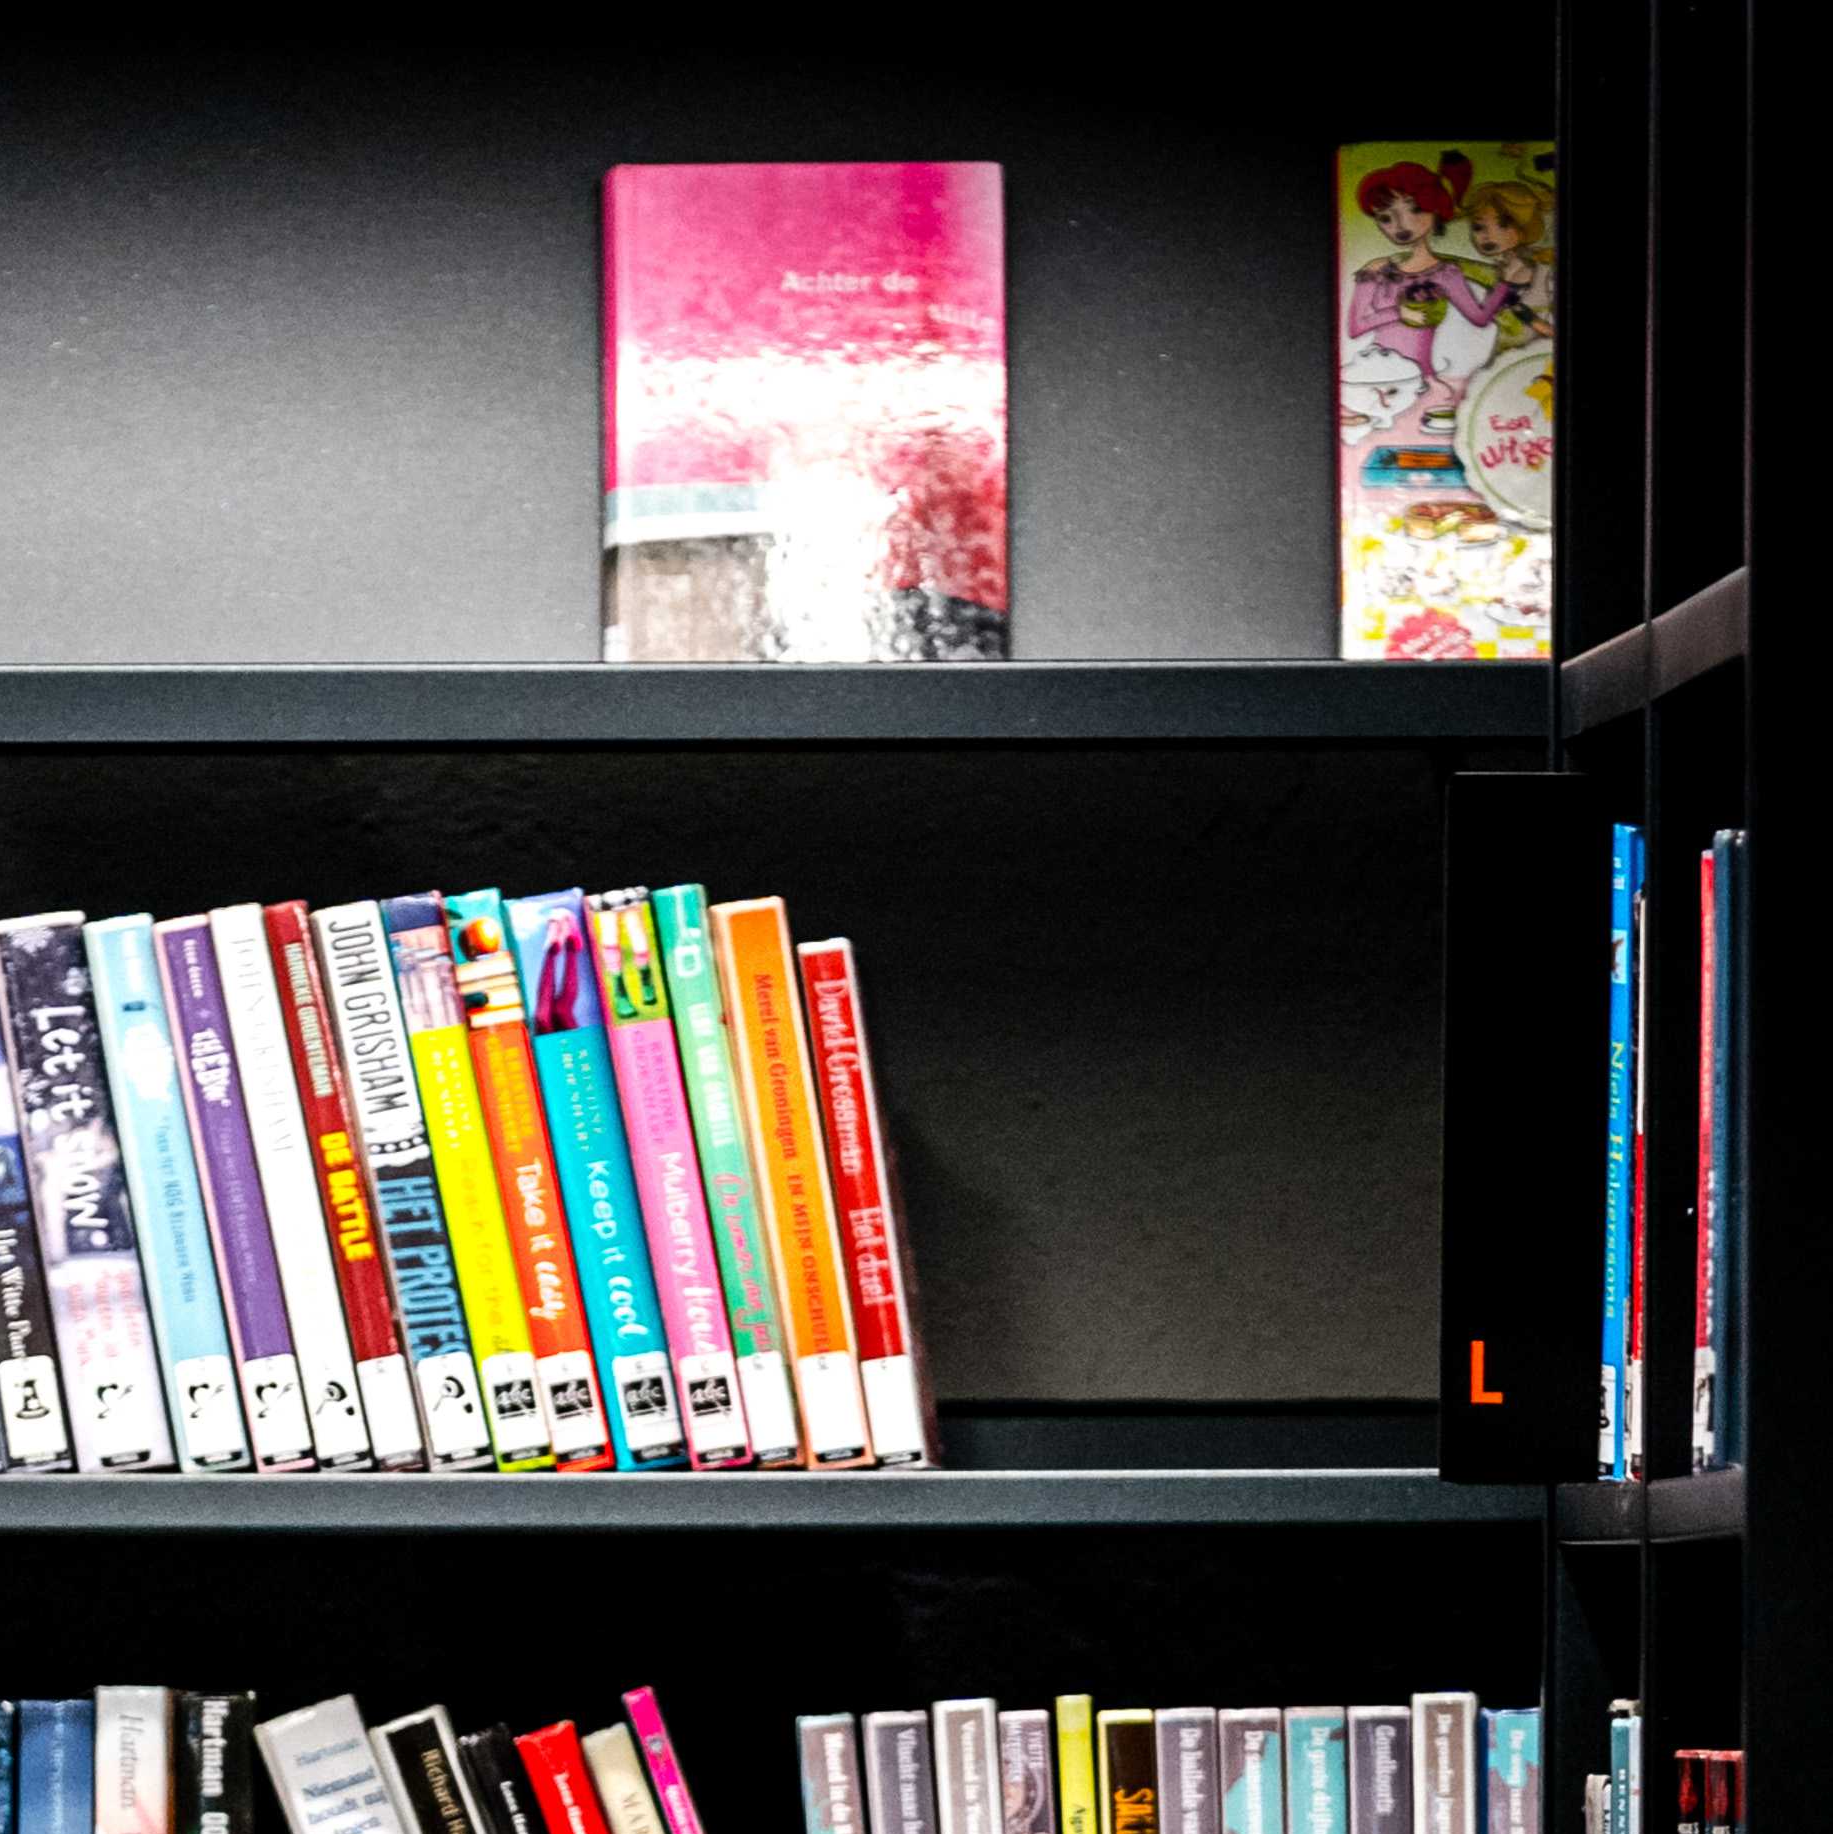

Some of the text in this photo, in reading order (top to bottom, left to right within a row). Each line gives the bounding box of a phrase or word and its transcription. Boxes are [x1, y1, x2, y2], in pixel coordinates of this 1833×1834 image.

[762, 1027, 785, 1060] van
[813, 978, 851, 1049] David
[32, 1004, 97, 1122] Let it
[328, 919, 436, 1234] JOHN GRISHAM HET
[762, 1063, 800, 1159] Groningen
[319, 1131, 373, 1263] DE BATTLE
[515, 1159, 551, 1227] Take
[528, 1233, 556, 1250] it
[660, 1152, 708, 1280] Mulberry
[585, 1160, 647, 1340] Keep it cool
[1471, 1340, 1503, 1403] L
[201, 1699, 231, 1797] Hartman
